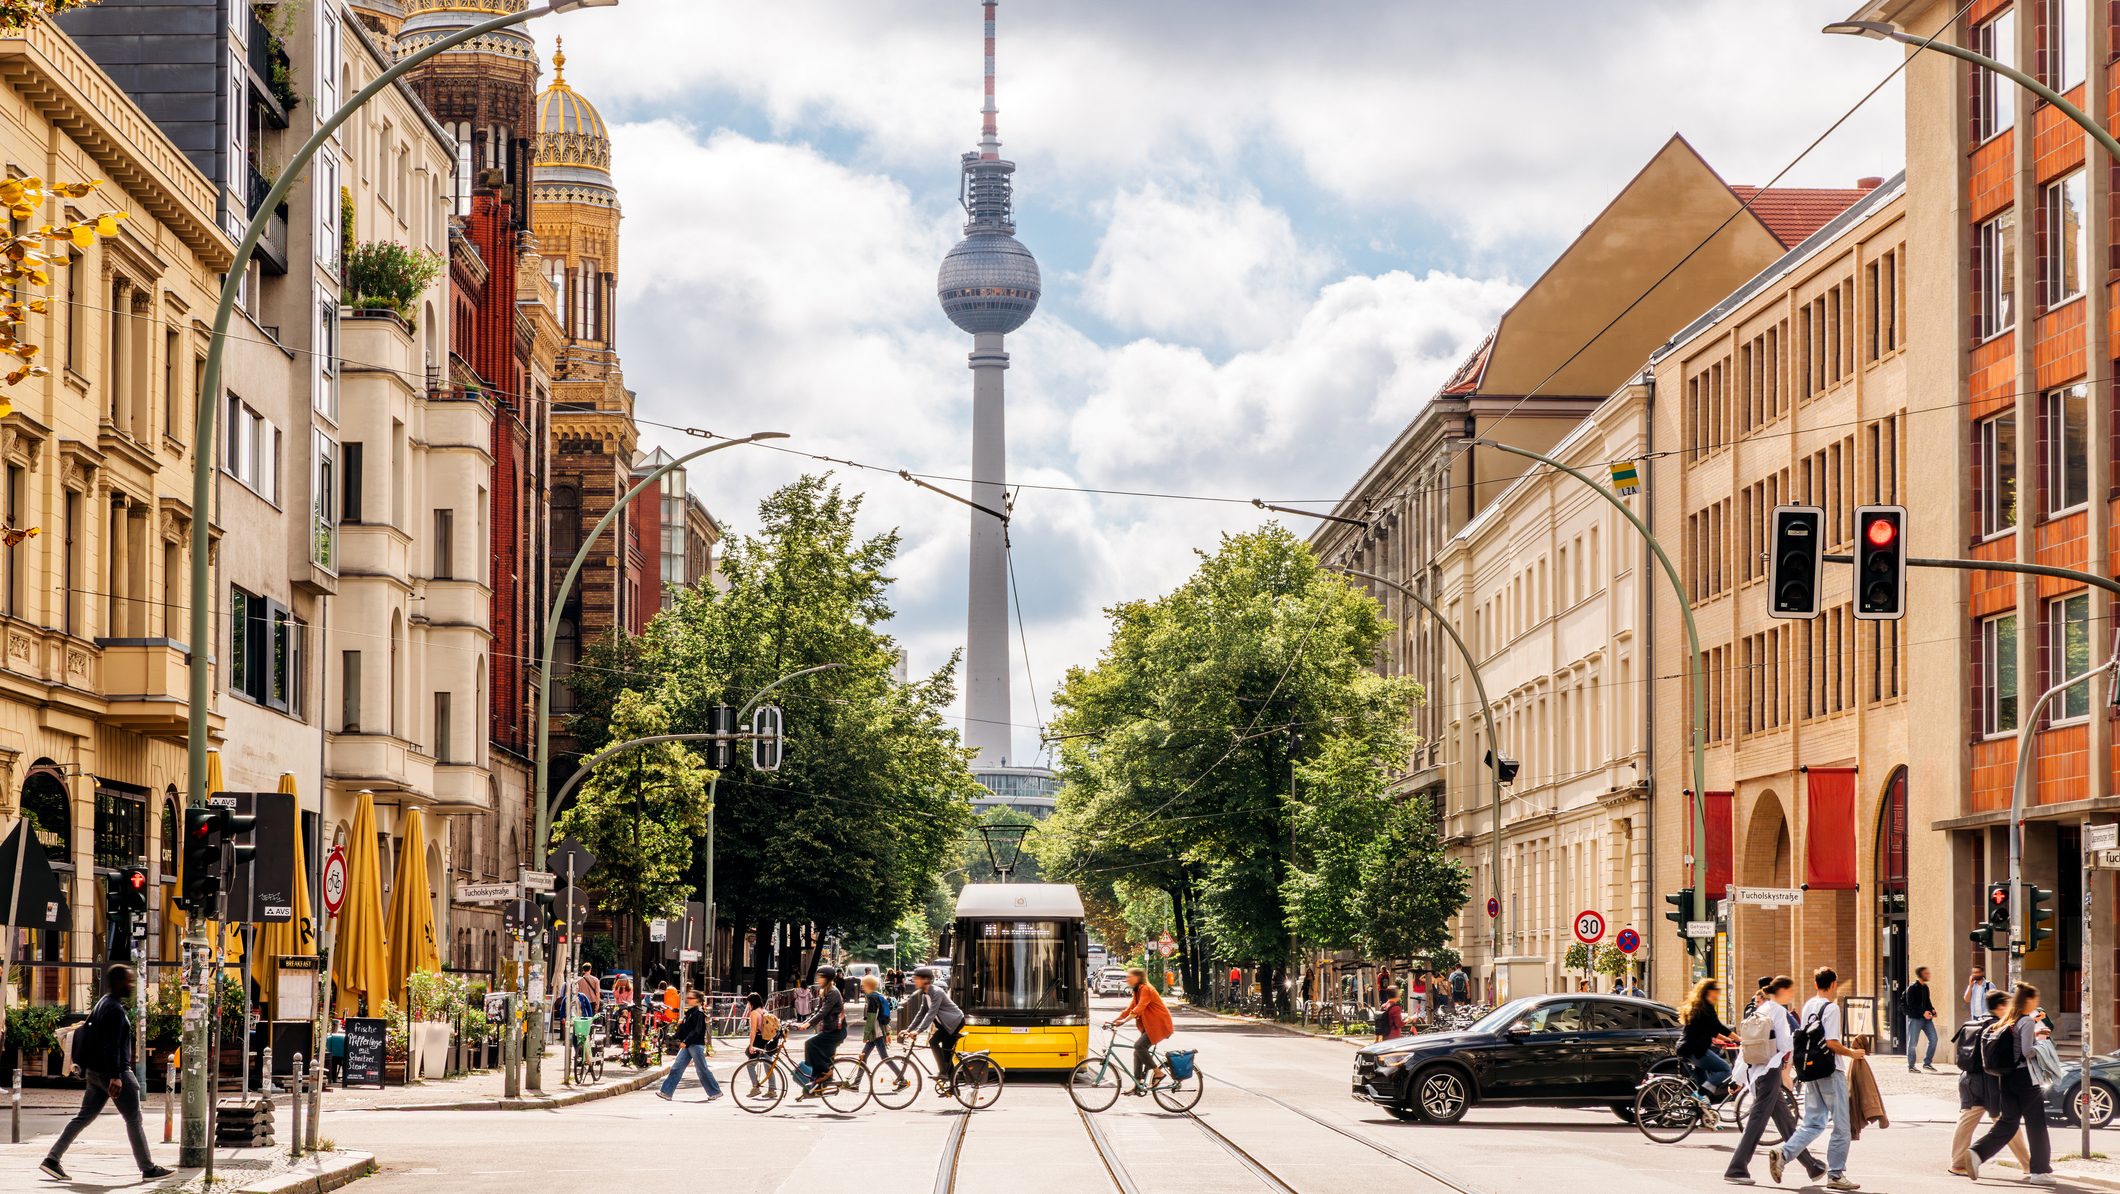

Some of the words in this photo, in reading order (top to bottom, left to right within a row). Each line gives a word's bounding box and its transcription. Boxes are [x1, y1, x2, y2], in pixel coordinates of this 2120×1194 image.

[1621, 486, 1637, 496] LZA
[464, 887, 510, 897] Tucholskystraße
[1741, 890, 1799, 902] Tucholskystraße
[1580, 919, 1599, 934] 30
[285, 960, 312, 968] BREAKFAST
[348, 1060, 367, 1070] Steak
